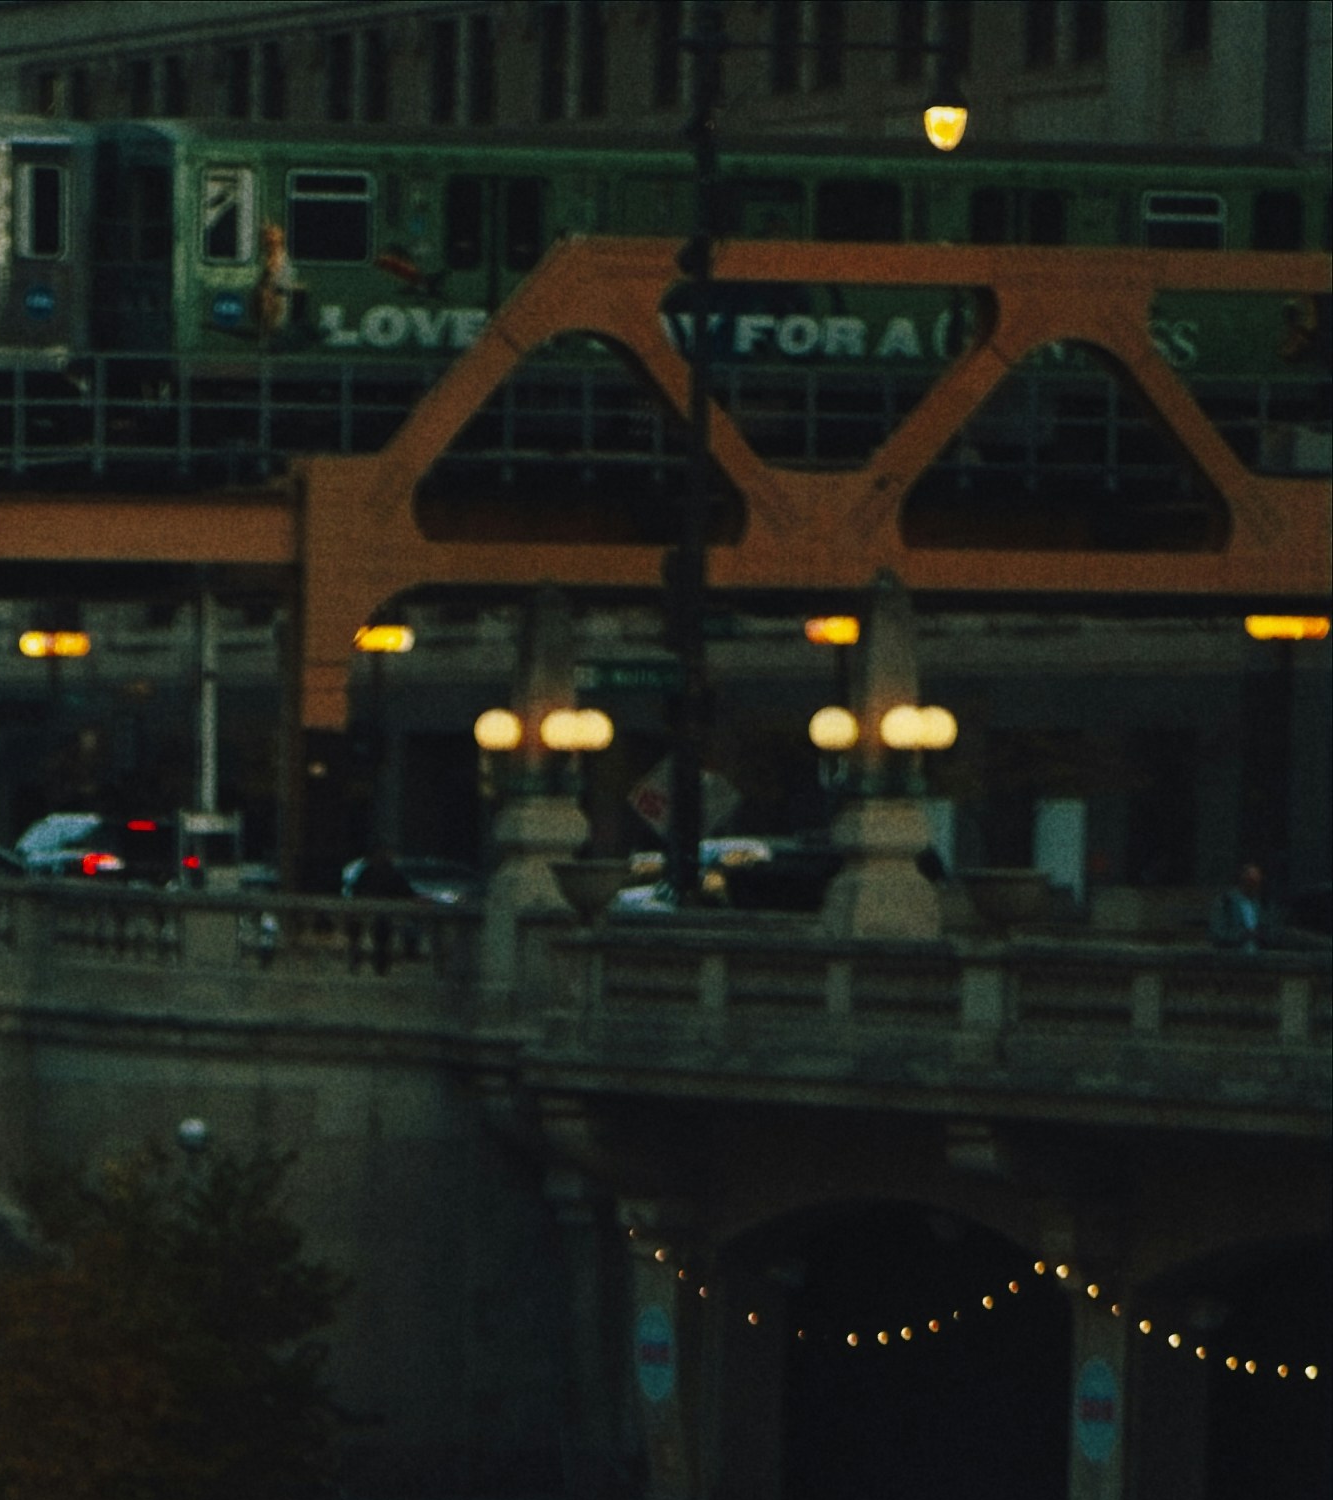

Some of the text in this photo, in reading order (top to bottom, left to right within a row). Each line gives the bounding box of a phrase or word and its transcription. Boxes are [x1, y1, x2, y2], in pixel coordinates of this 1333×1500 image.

[319, 304, 491, 348] LOVE
[734, 313, 866, 358] FOR
[876, 317, 923, 359] A
